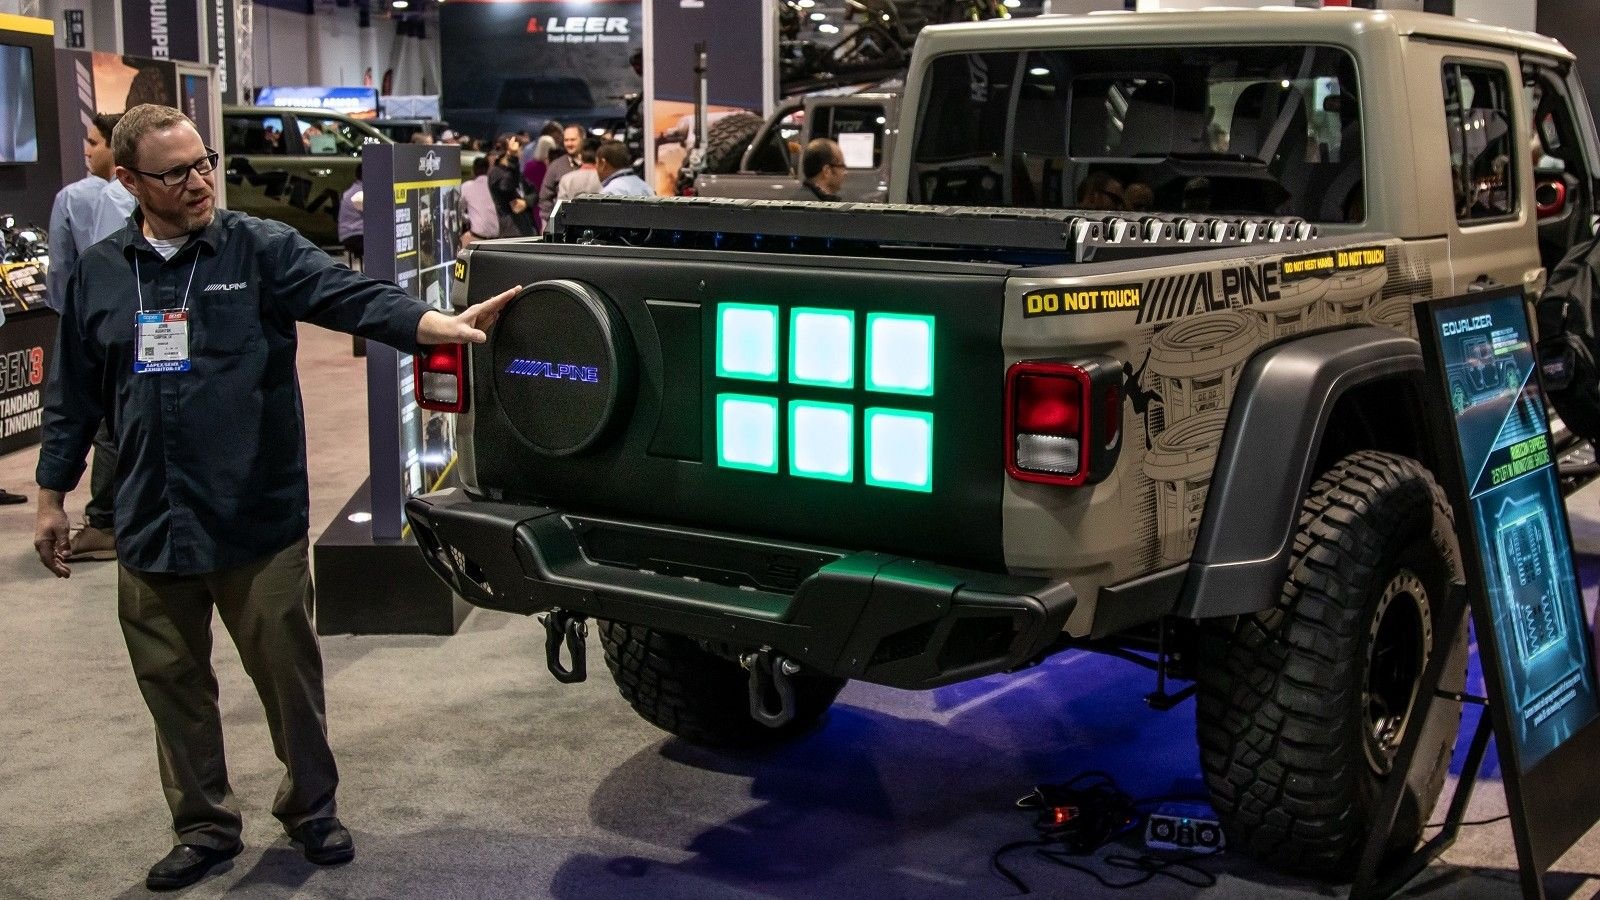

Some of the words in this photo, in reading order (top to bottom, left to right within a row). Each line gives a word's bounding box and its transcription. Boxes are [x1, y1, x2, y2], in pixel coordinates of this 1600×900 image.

[546, 17, 629, 33] LEER
[1284, 263, 1293, 274] DO
[1294, 261, 1304, 272] NOT
[1338, 252, 1348, 267] DO
[1349, 251, 1362, 266] NOT
[1363, 249, 1385, 264] TOUCH
[217, 282, 247, 291] ALPINE
[1187, 262, 1281, 315] ALPINE
[1028, 294, 1058, 313] DO
[1065, 291, 1099, 311] NOT
[1101, 288, 1140, 309] TOUCH
[1442, 314, 1492, 337] EQUALIZER
[533, 361, 598, 382] ALPINE
